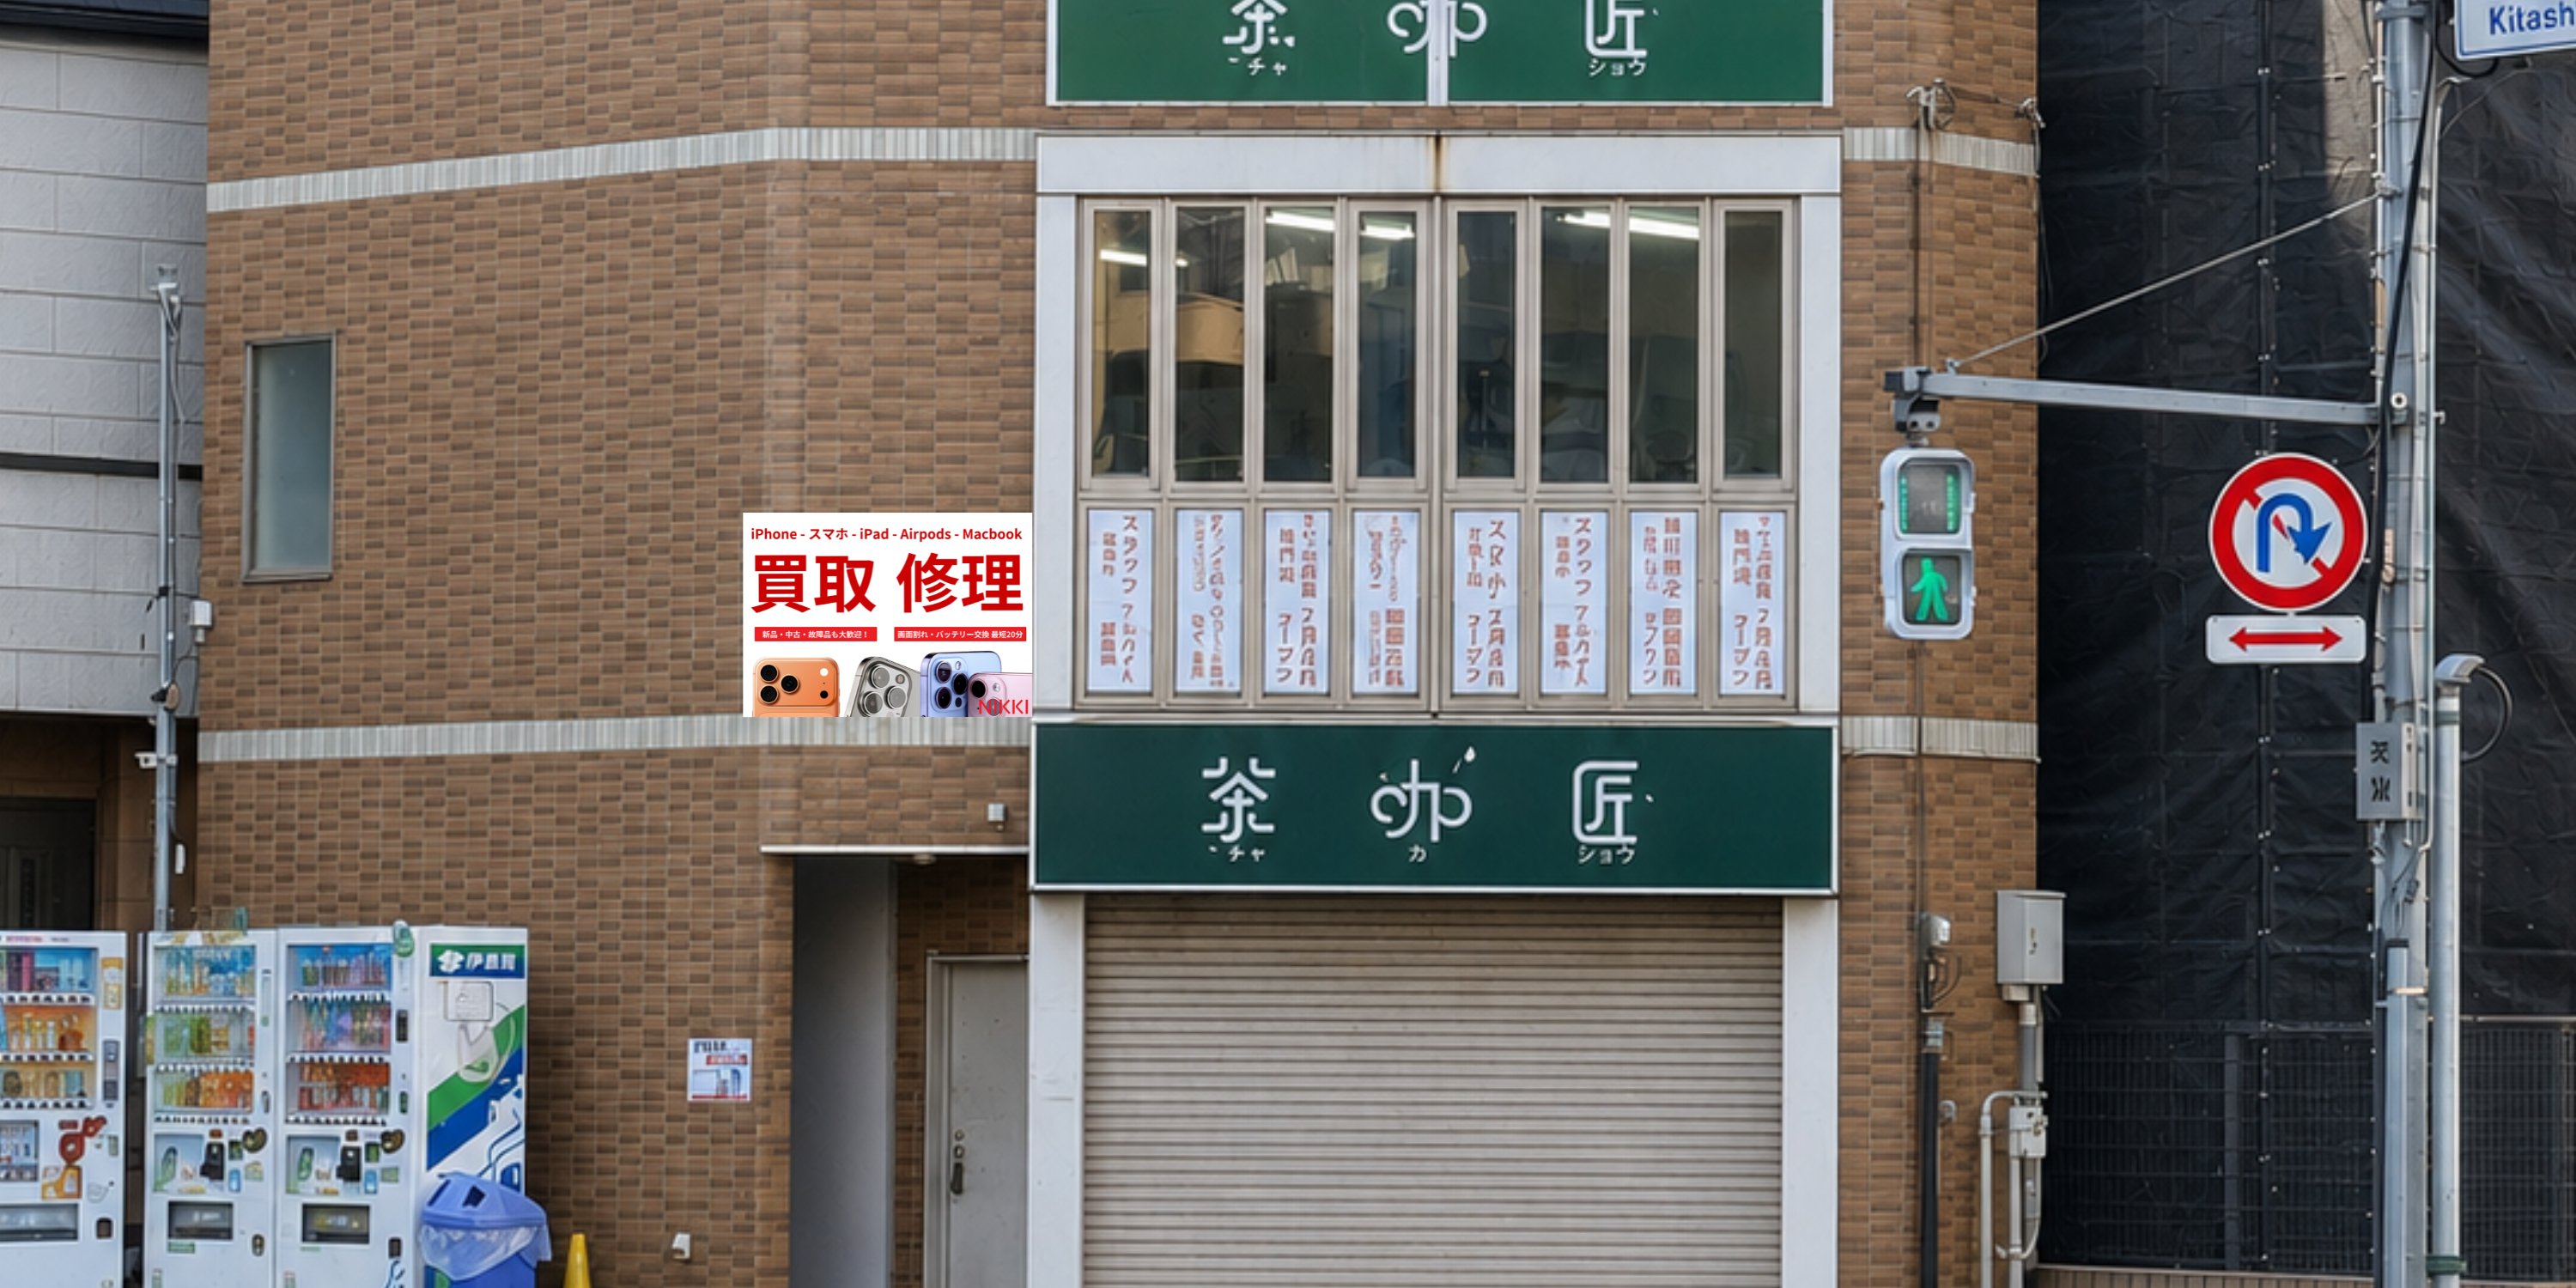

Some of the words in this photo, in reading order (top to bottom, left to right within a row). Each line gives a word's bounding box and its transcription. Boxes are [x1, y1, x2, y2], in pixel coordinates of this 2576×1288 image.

[2489, 1, 2574, 35] Kitash
[750, 527, 798, 540] iPhone
[809, 527, 848, 540] スマホ
[860, 527, 890, 540] iPad
[900, 527, 951, 543] Airpods
[963, 527, 1023, 540] Macbook
[750, 554, 877, 613] 買取
[896, 552, 1024, 613] 修理
[762, 630, 868, 639] 新品・中古・故障品も大歓迎！
[897, 630, 989, 639] 画面割れ・バッテリー交換
[991, 630, 1024, 639] 最短20分
[978, 699, 1029, 715] NIKKI
[1409, 845, 1426, 862] カ
